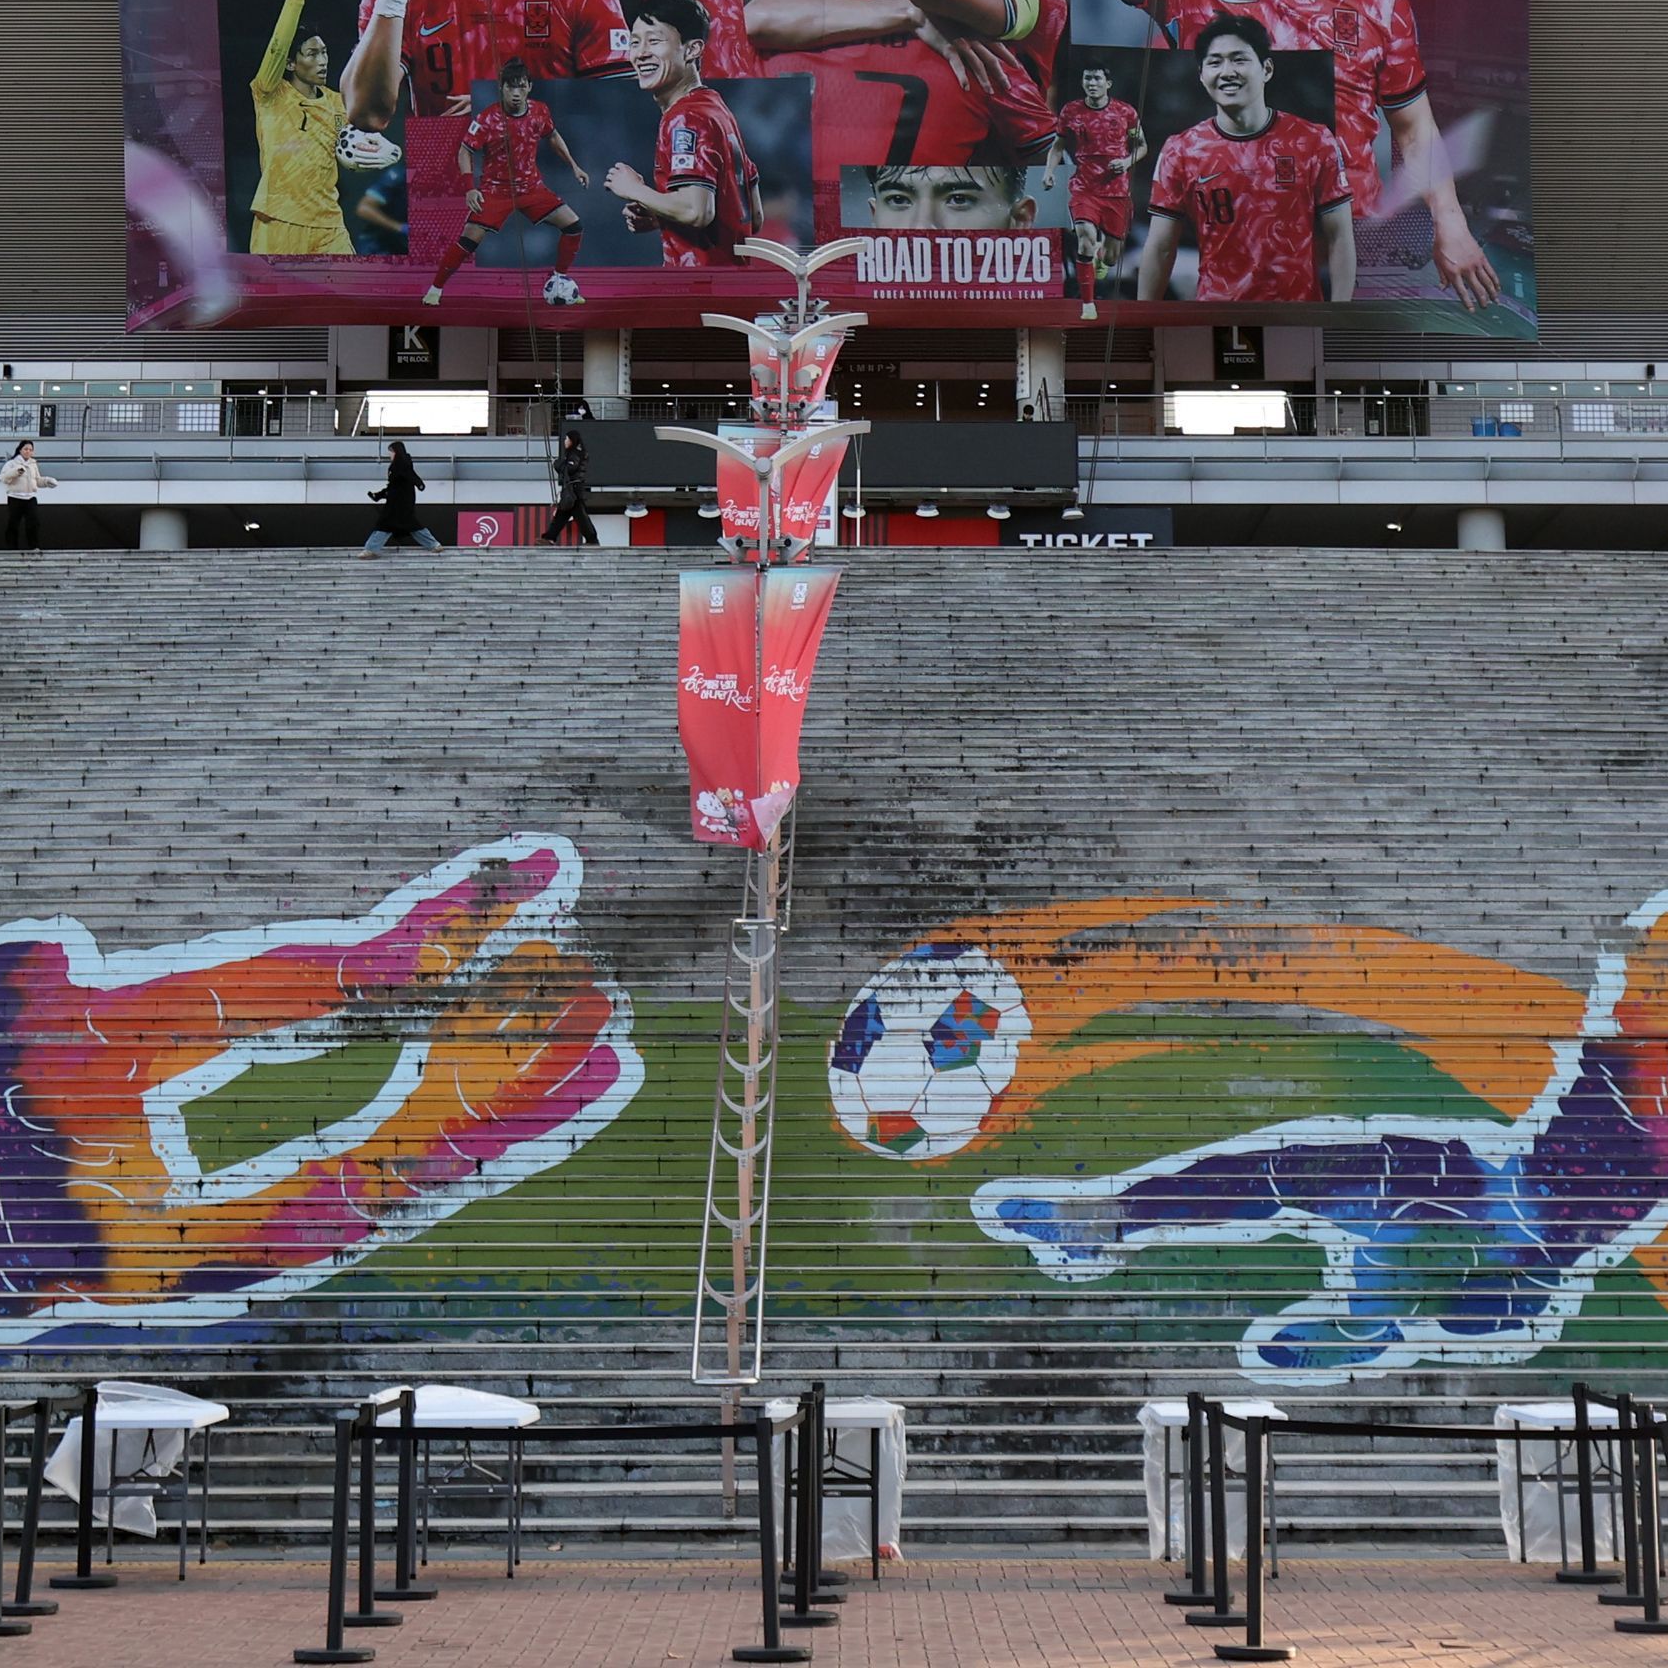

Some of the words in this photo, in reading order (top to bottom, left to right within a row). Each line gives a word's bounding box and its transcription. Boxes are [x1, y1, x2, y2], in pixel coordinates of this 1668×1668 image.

[427, 42, 453, 95] 9
[855, 70, 930, 166] 7
[856, 236, 932, 283] ROAD
[935, 236, 973, 283] TO
[976, 236, 1052, 283] 2026
[873, 290, 905, 299] KOREA
[909, 290, 957, 300] NATIONAL
[963, 290, 1013, 300] FOOTBALL
[1018, 290, 1045, 300] TEAM
[404, 325, 424, 349] K
[1233, 325, 1248, 350] L
[724, 685, 754, 712] Reds
